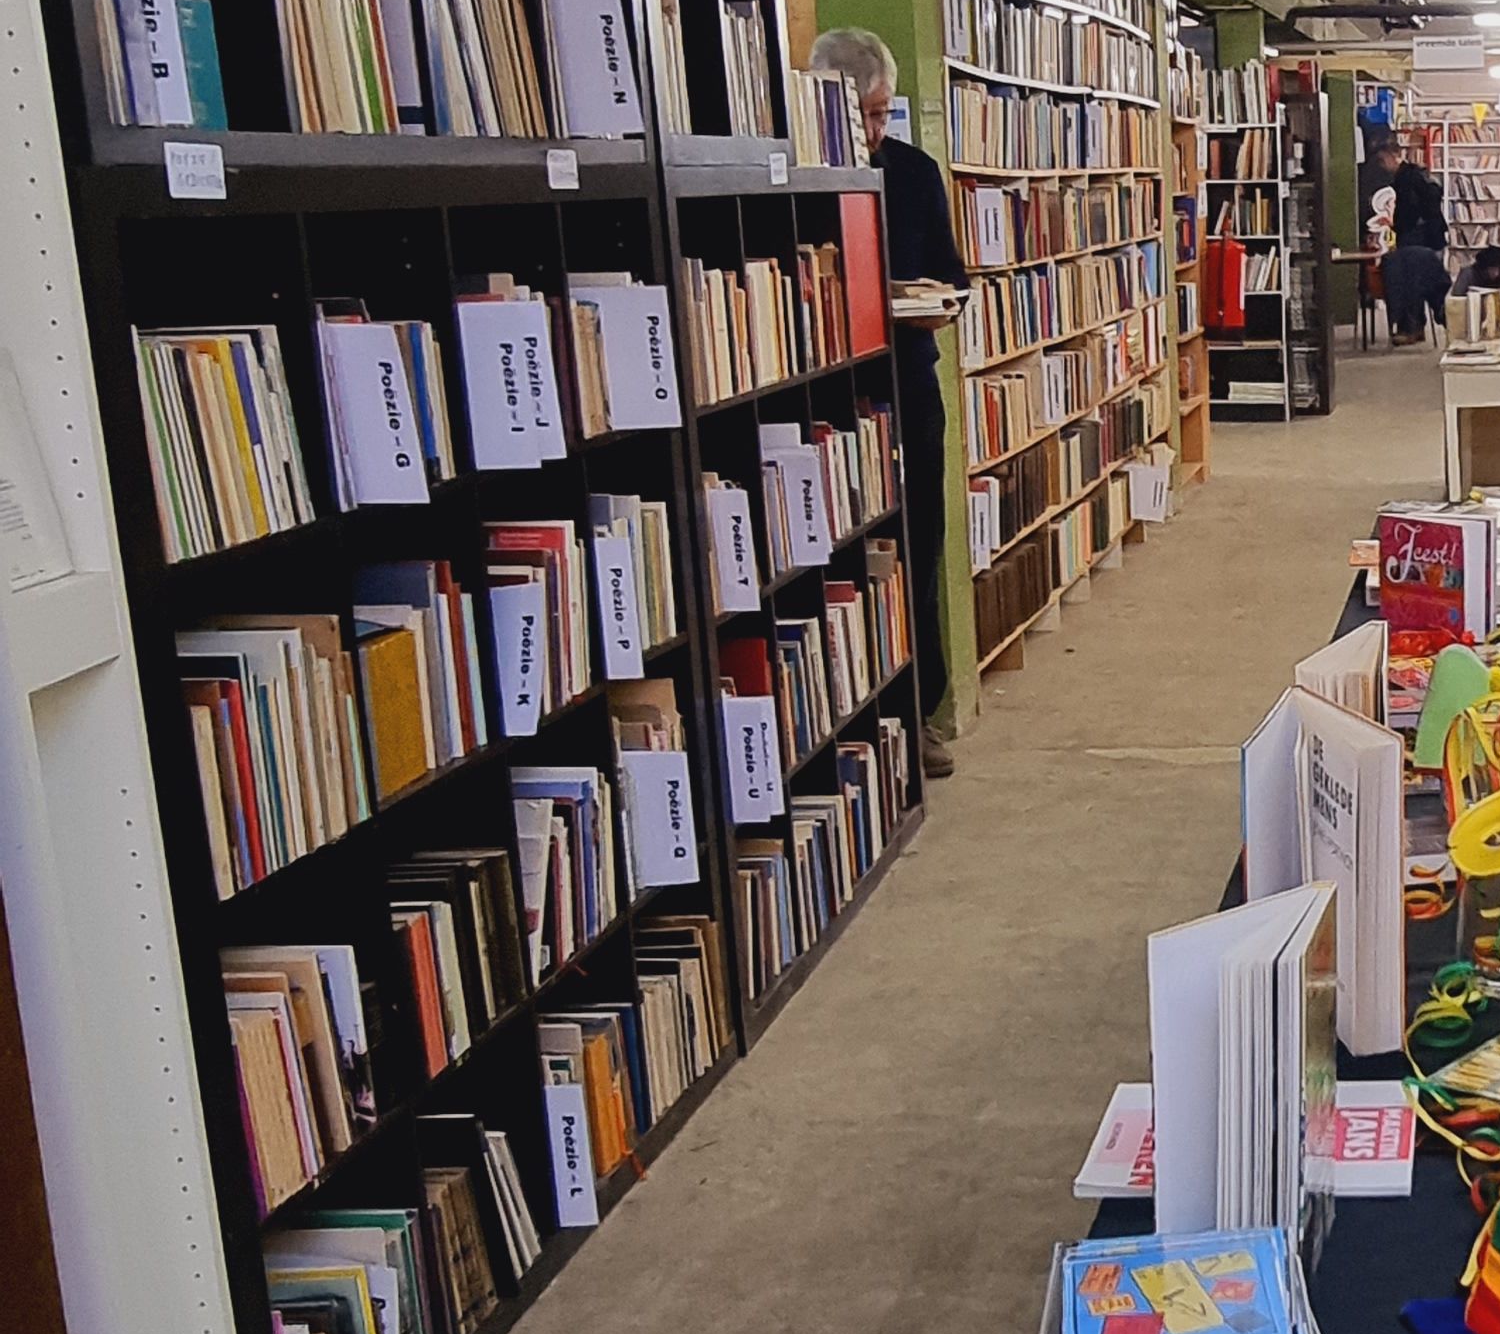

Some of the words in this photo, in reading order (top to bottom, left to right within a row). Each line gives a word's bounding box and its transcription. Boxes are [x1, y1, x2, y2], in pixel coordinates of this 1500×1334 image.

[152, 62, 169, 79] B
[600, 14, 619, 72] Poëzie
[613, 91, 627, 104] N
[647, 316, 663, 371] Poëzie
[500, 343, 518, 407] Poëzie
[524, 337, 542, 398] Poëzie
[535, 417, 549, 428] J
[378, 362, 402, 430] Poëzie
[395, 453, 410, 468] G
[732, 515, 744, 566] Poëzie
[738, 577, 748, 586] T
[610, 568, 628, 623] Poëzie
[521, 615, 534, 675] Poëzie
[618, 639, 630, 650] P
[517, 694, 531, 706] K
[742, 727, 755, 773] Poëzie
[667, 780, 682, 833] Poëzie
[748, 789, 760, 799] U
[561, 1115, 577, 1168] Poëzie
[569, 1186, 583, 1197] L
